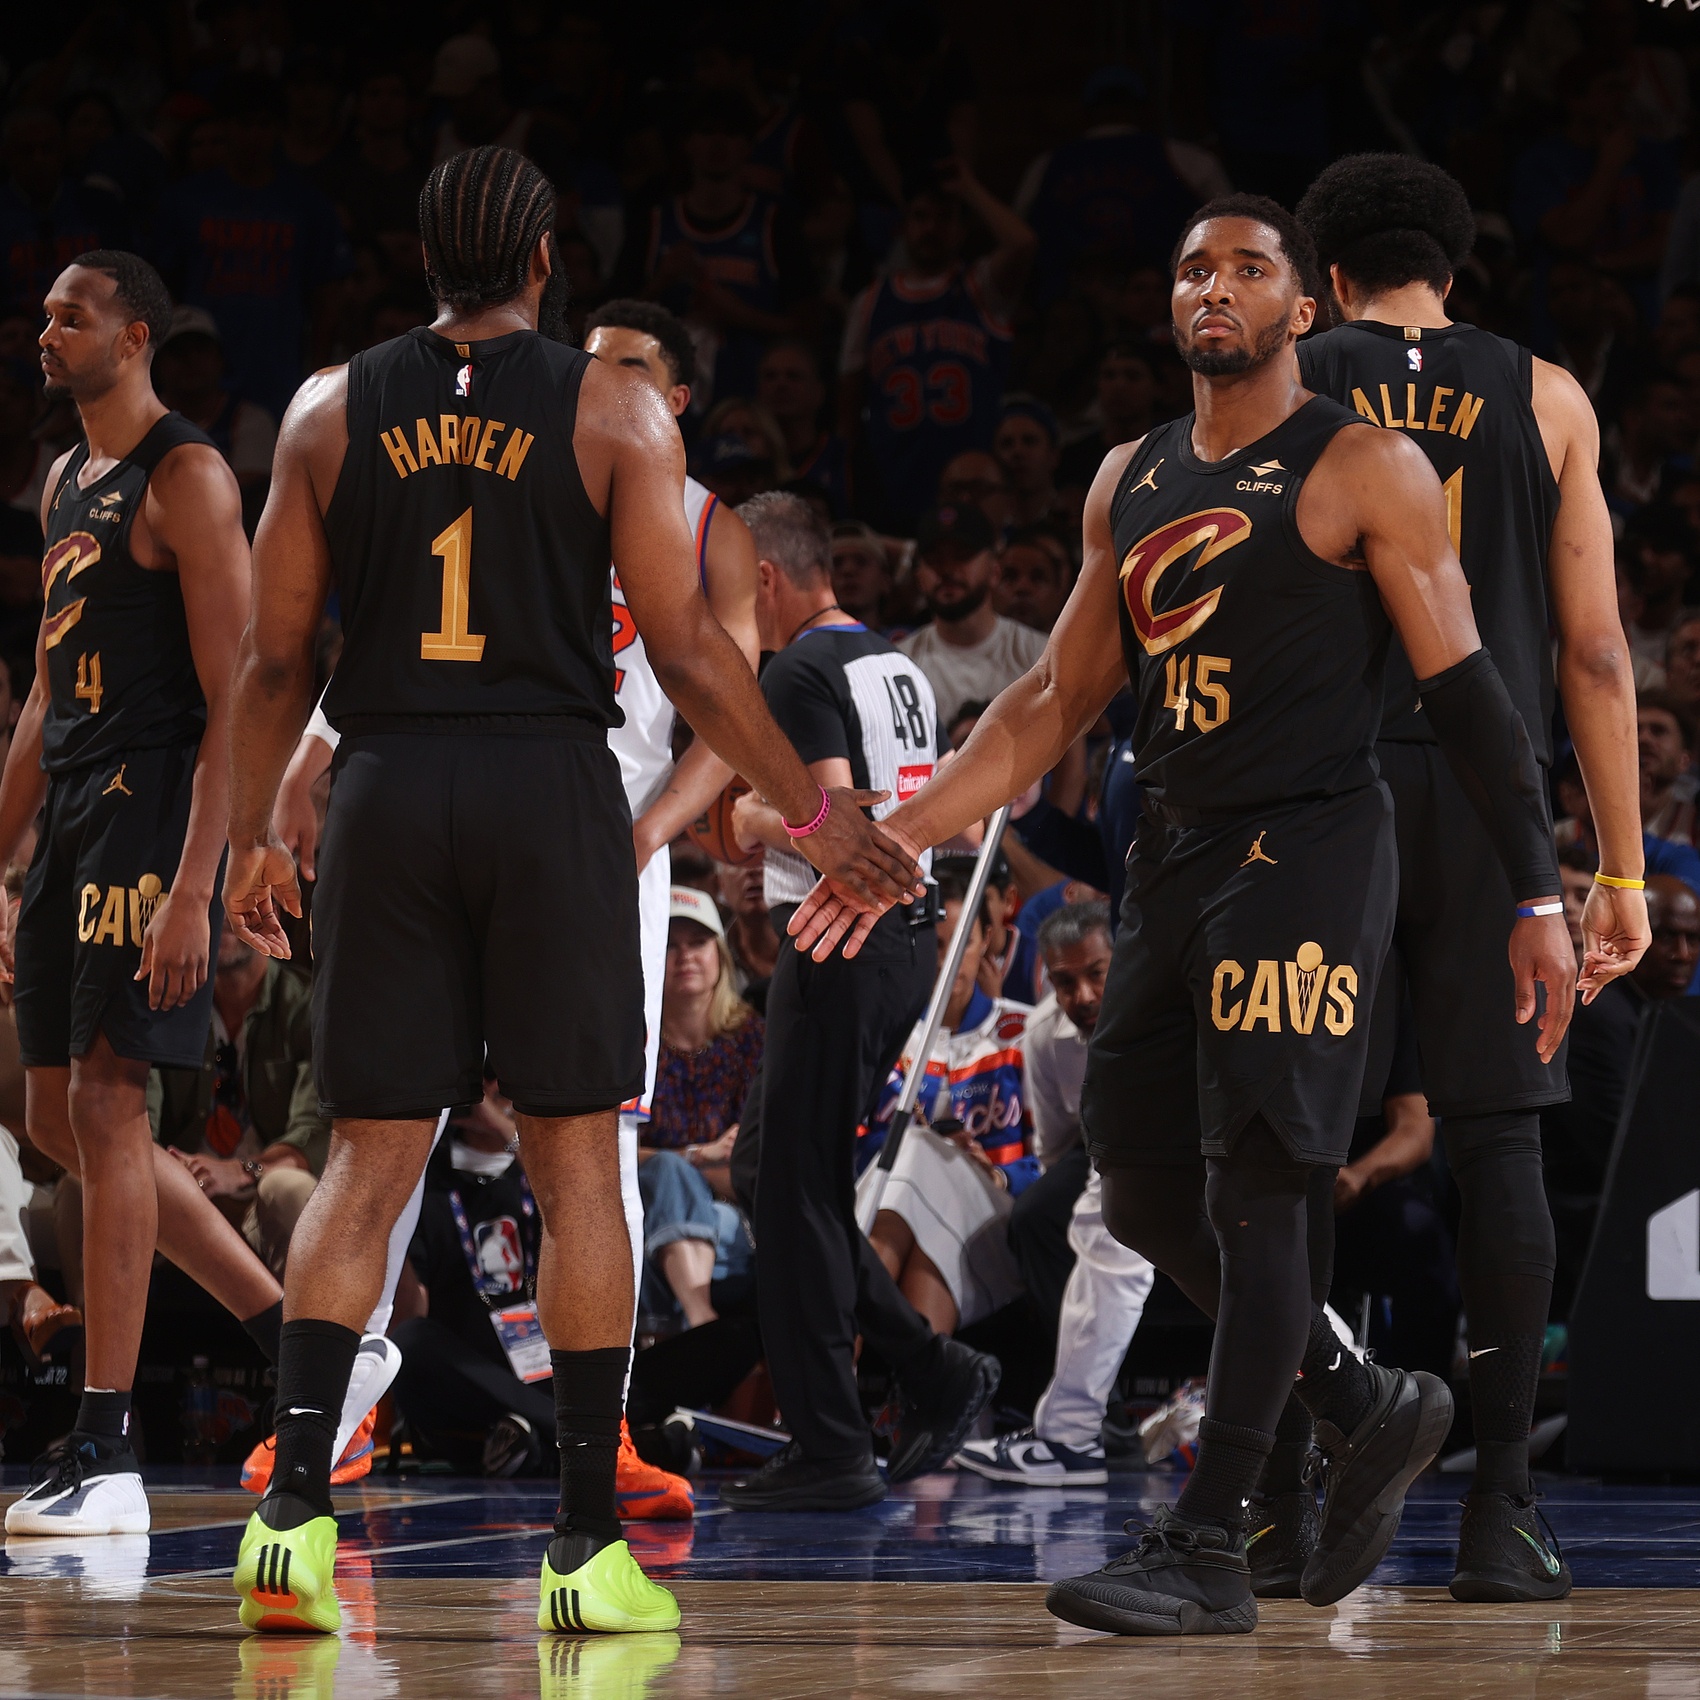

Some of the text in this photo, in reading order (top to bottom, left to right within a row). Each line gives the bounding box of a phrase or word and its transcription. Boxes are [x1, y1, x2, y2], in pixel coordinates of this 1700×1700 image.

[883, 364, 972, 430] 33
[1351, 382, 1485, 441] ALLEN
[379, 413, 535, 482] HARDEN
[89, 508, 121, 524] CLIFFS
[1235, 479, 1283, 495] CLIFFS
[420, 504, 487, 663] 1
[75, 650, 104, 714] 4
[883, 674, 927, 750] 48
[1163, 653, 1232, 734] 45
[898, 772, 931, 793] Emirat
[78, 872, 170, 948] CAV
[1211, 940, 1359, 1037] CAVS
